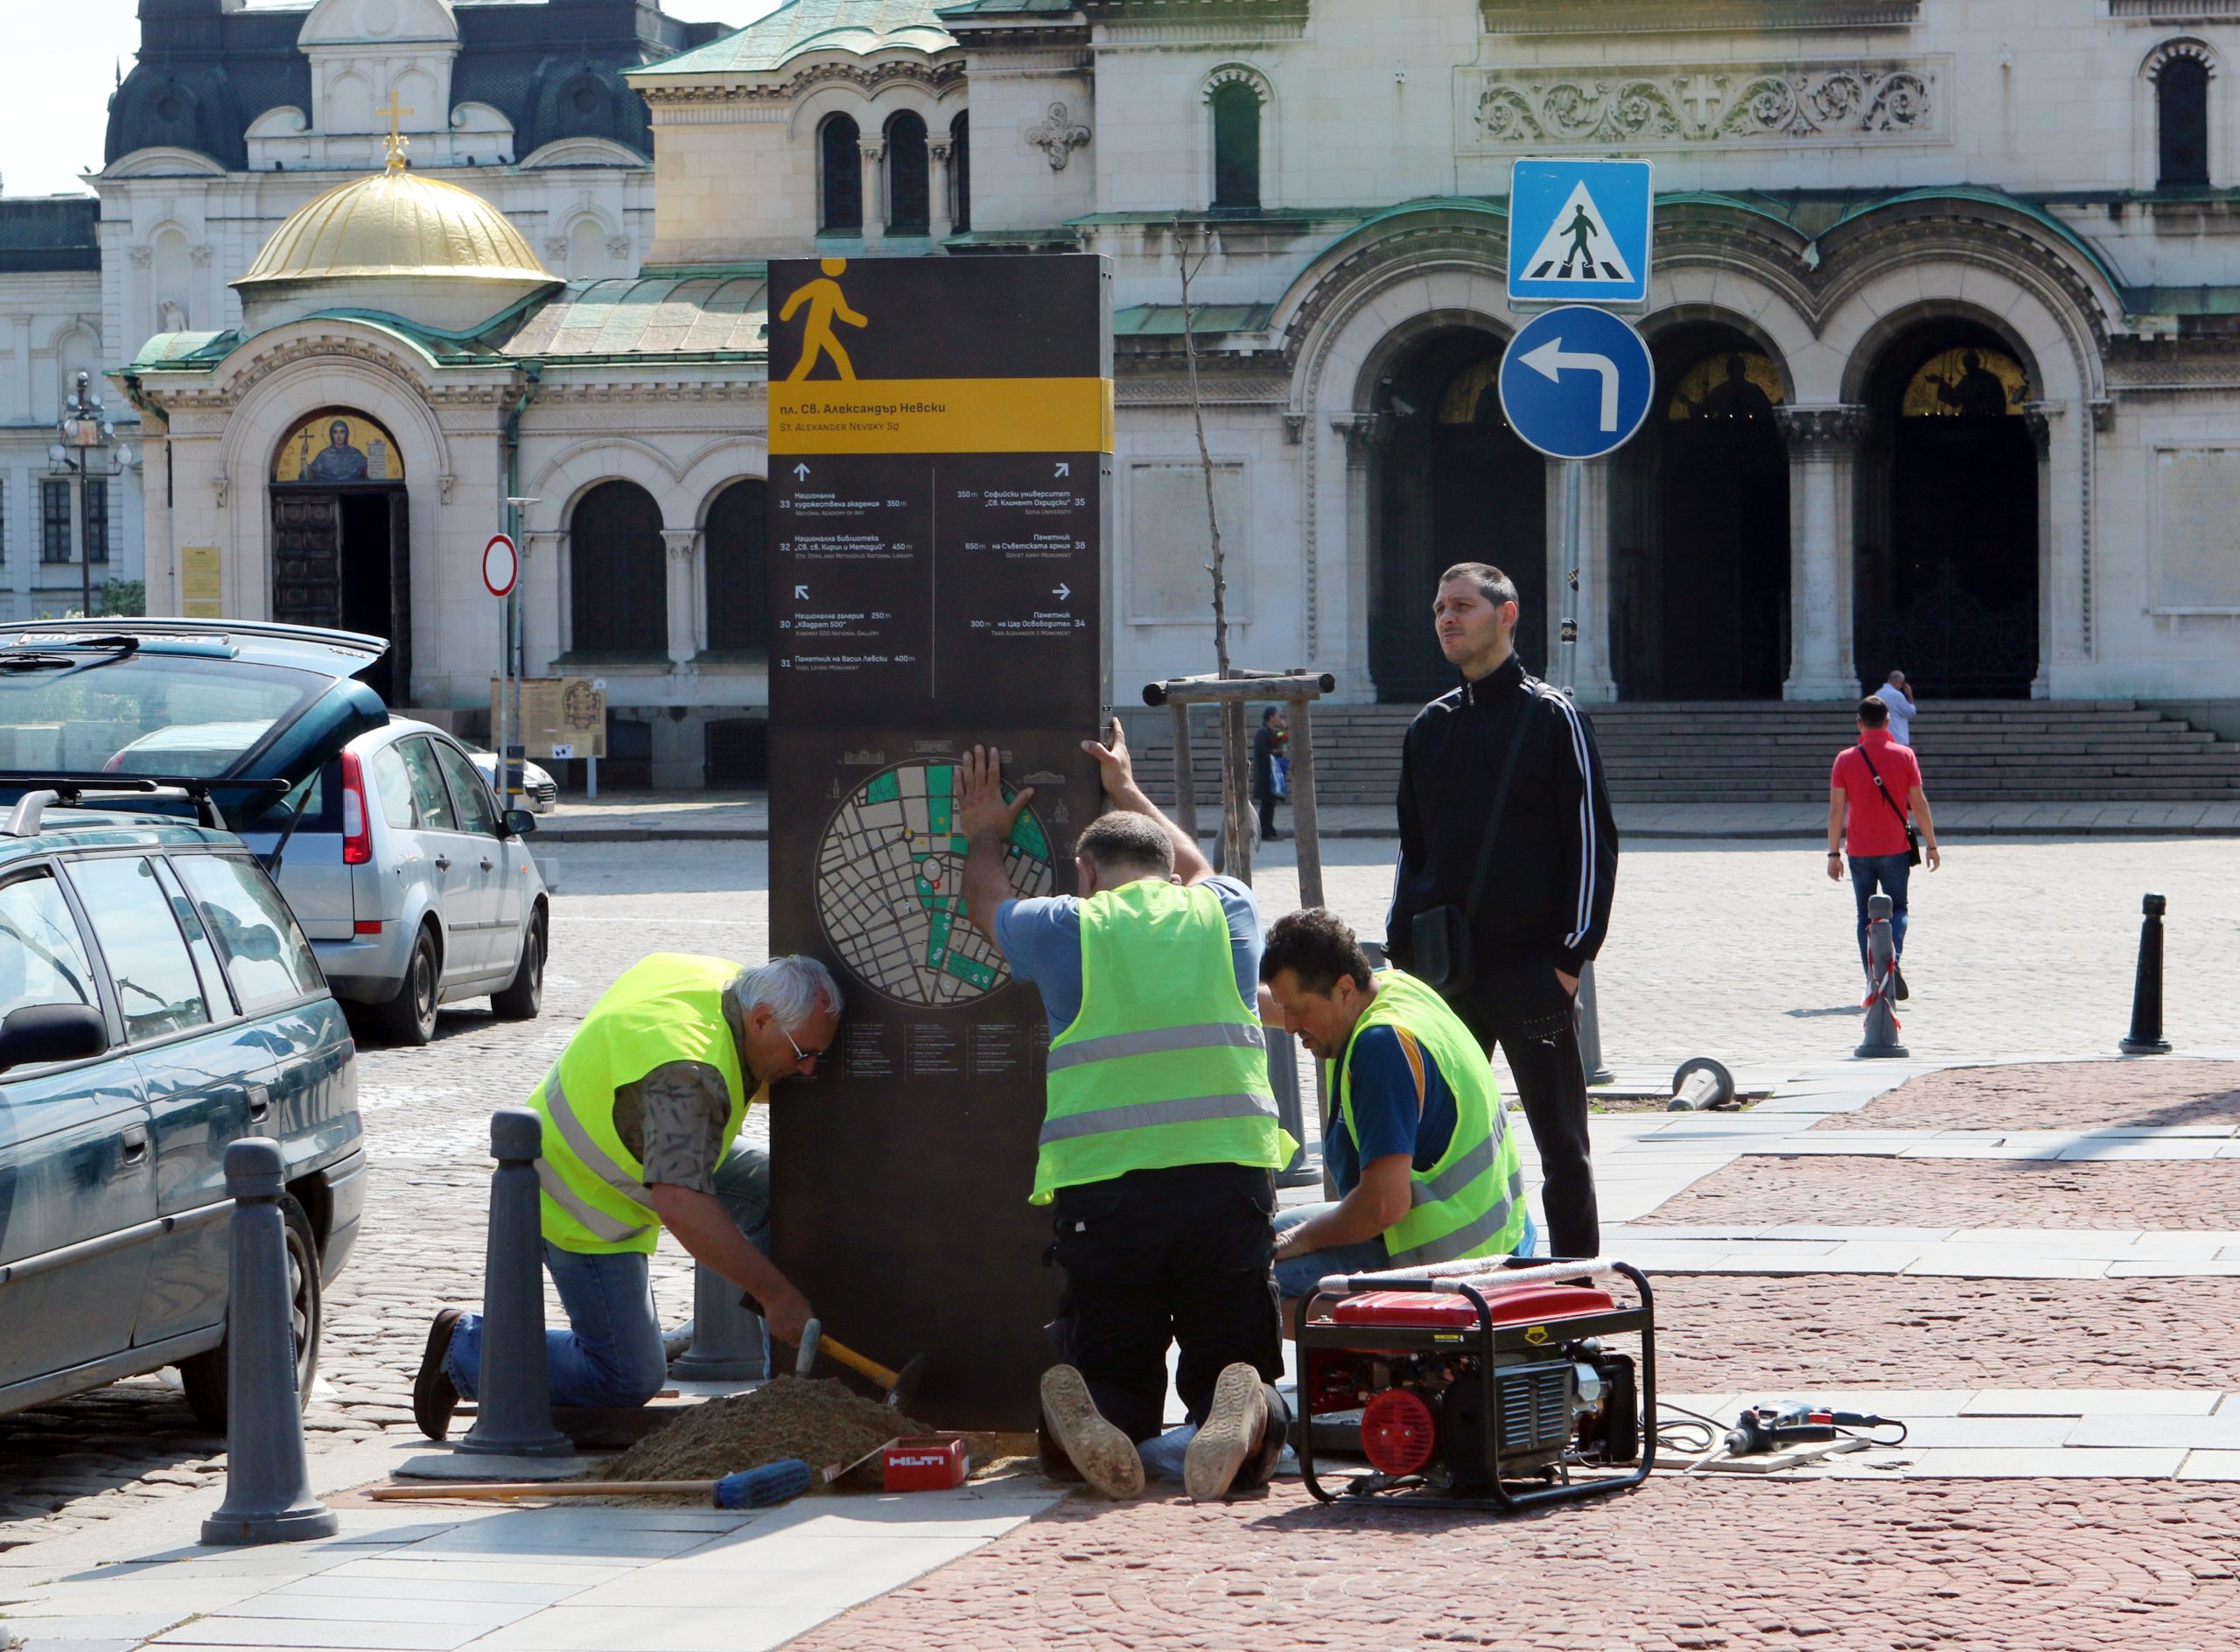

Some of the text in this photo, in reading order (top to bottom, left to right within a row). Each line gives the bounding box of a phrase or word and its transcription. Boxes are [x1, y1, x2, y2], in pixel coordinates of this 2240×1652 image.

[802, 404, 820, 414] Св.
[824, 403, 896, 415] Александър
[900, 403, 945, 413] Невски
[795, 423, 846, 431] ALEXANDER
[890, 1456, 944, 1466] HILTI
